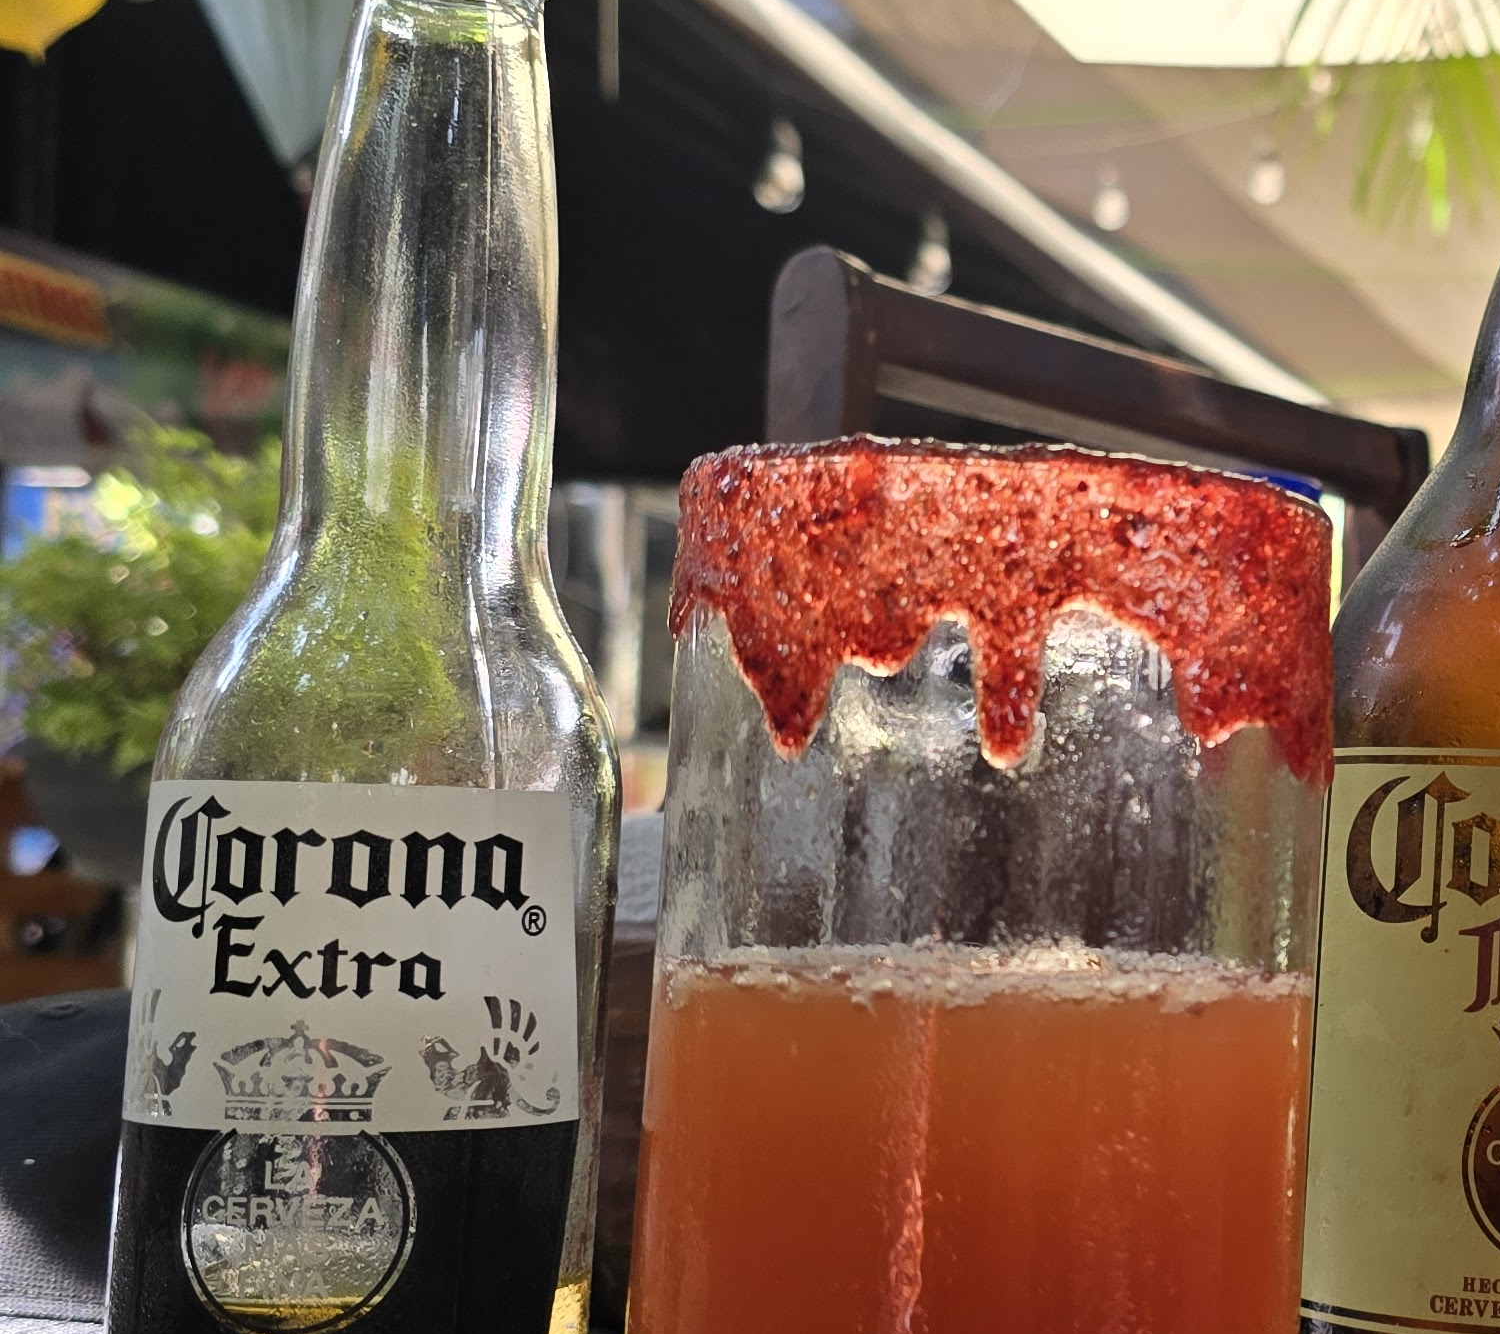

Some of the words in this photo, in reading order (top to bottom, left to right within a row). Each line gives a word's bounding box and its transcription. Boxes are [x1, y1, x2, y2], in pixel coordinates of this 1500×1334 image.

[152, 794, 530, 938] Corona
[210, 914, 447, 1000] Extra
[264, 1160, 311, 1192] LA
[202, 1194, 387, 1228] CERVEZA
